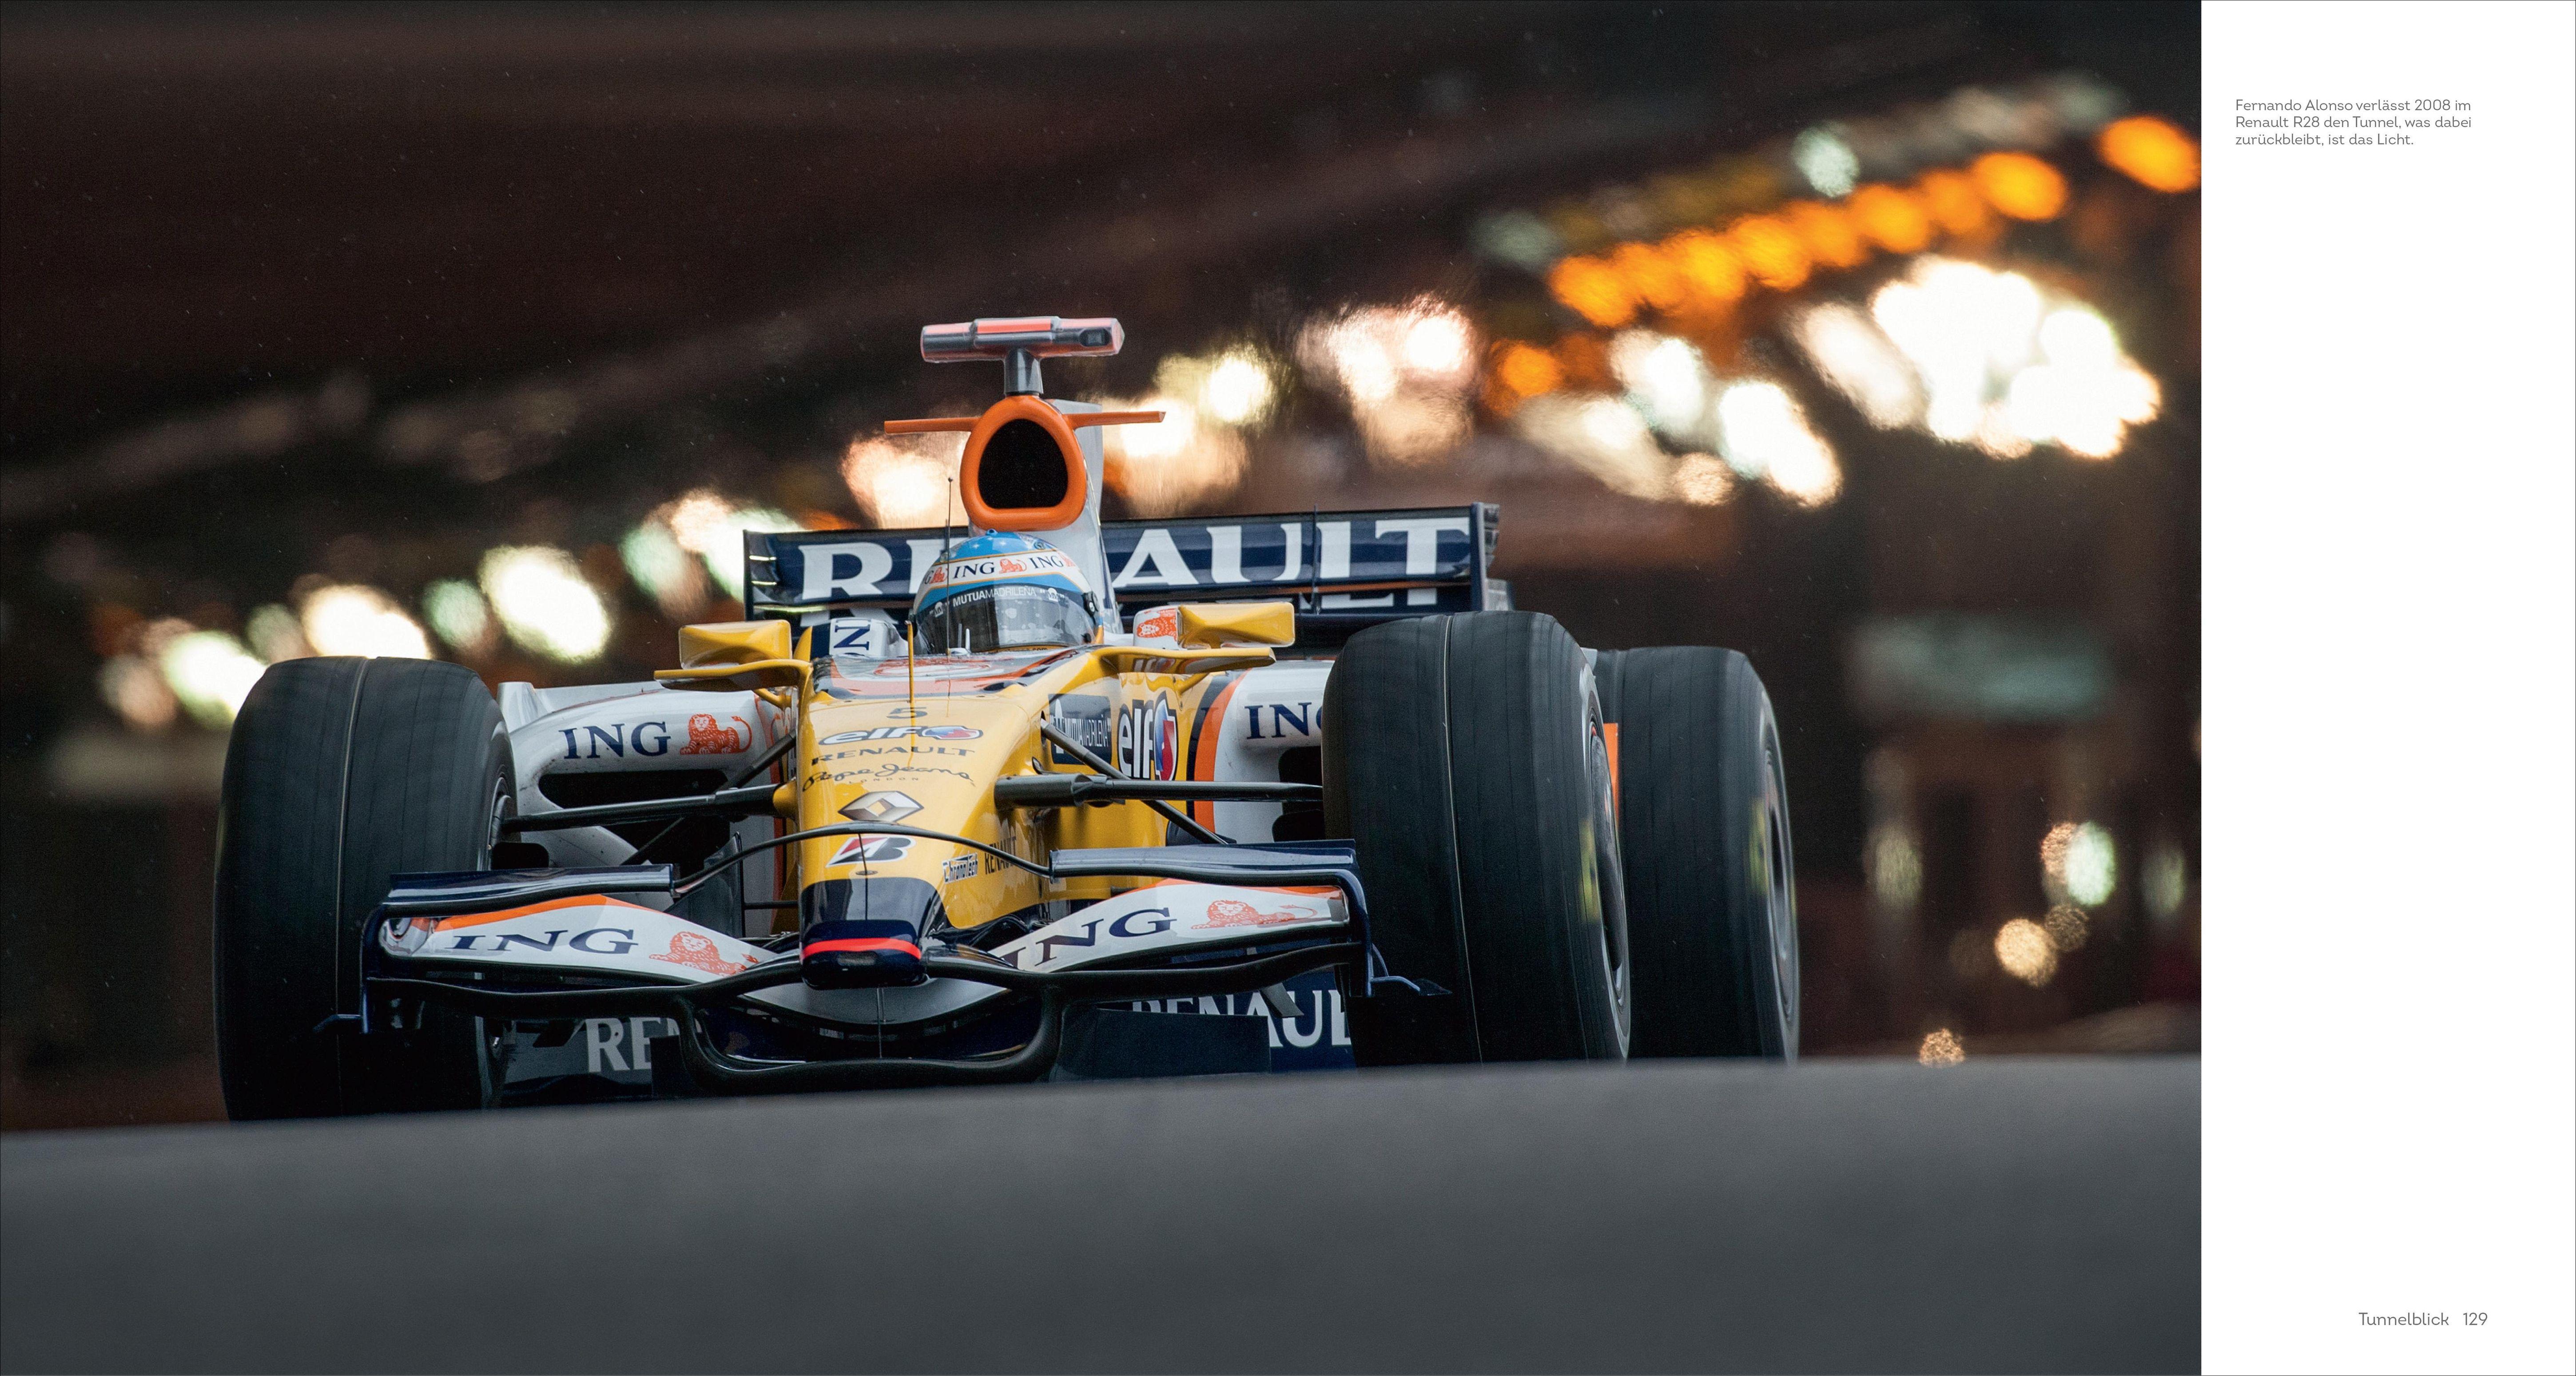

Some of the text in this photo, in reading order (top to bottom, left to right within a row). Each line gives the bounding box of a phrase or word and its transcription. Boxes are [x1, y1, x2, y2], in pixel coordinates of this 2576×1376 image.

[953, 555, 1063, 579] ING ING
[886, 707, 928, 719] 5
[1244, 702, 1322, 739] IN
[558, 721, 671, 759] ING
[1117, 699, 1154, 779] elf
[811, 746, 975, 766] RENAULT
[802, 764, 976, 792] Pepe Jeans
[445, 928, 640, 954] ING
